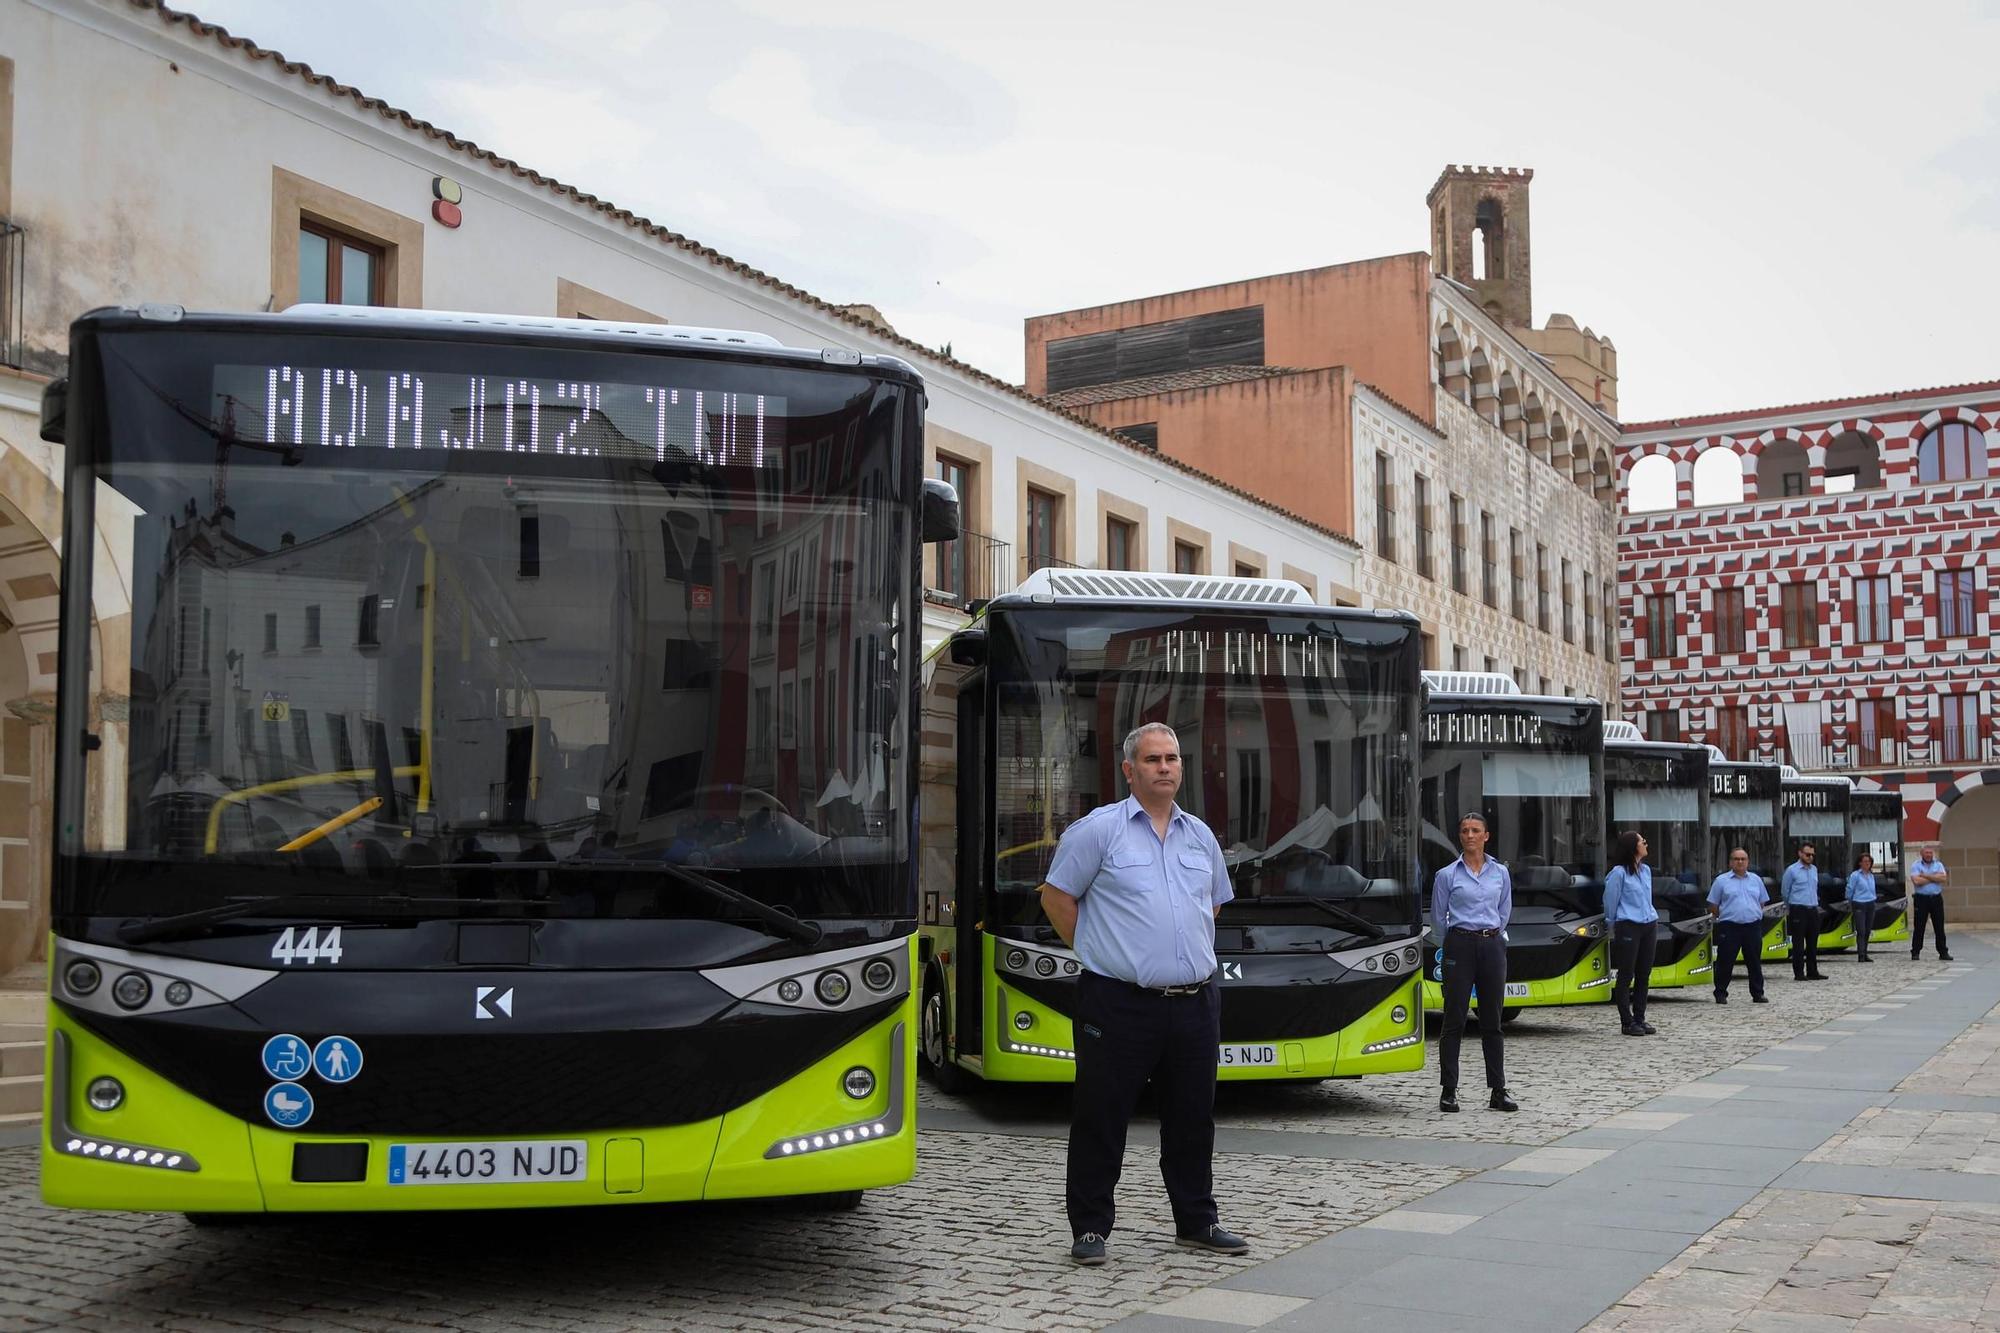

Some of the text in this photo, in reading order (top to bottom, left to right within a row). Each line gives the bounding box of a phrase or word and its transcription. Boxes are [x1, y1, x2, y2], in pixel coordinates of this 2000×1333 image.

[1166, 630, 1337, 679] AYUNTA
[1714, 774, 1732, 794] DE
[271, 926, 343, 965] 444
[1506, 984, 1527, 996] NJD
[1241, 1047, 1273, 1063] NJD
[393, 1146, 578, 1179] E 4403 NJD
